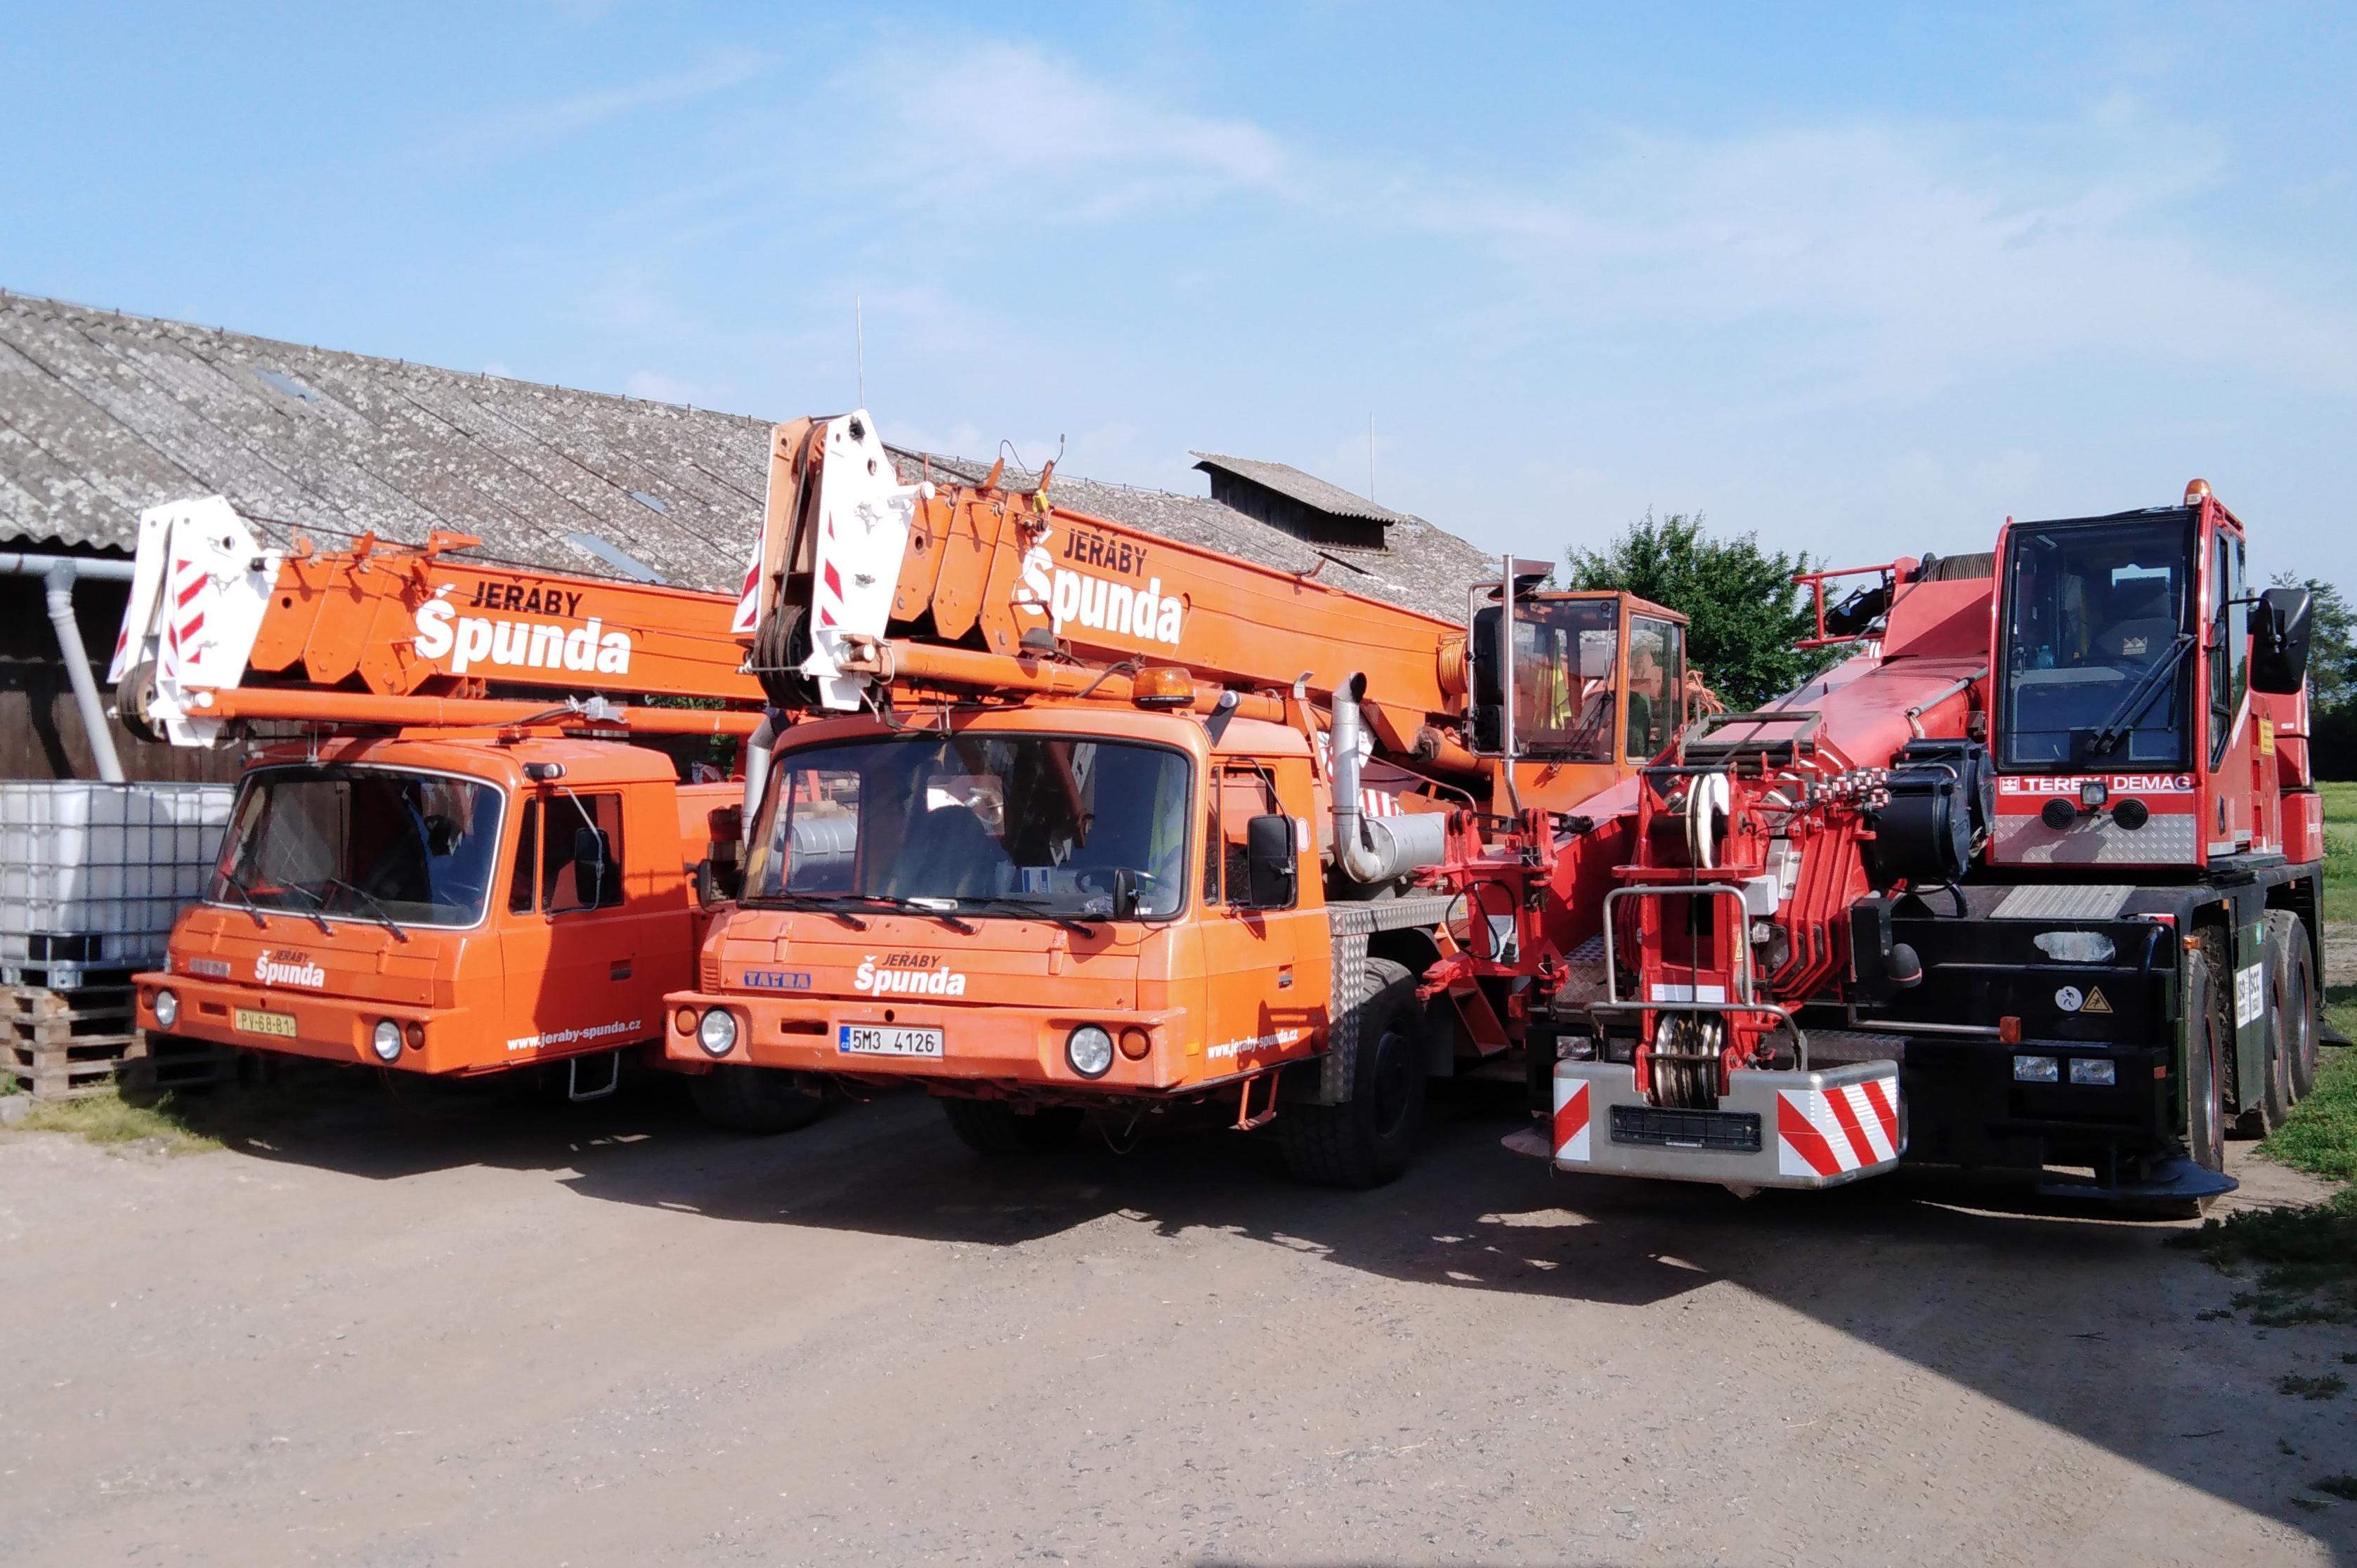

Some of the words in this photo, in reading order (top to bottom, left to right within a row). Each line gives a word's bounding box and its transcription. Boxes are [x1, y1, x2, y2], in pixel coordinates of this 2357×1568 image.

[1063, 527, 1147, 577] JEŘÁBY
[469, 576, 584, 617] JEŘÁBY
[2114, 776, 2190, 790] DEMAG
[254, 950, 325, 987] Špunda
[882, 950, 941, 968] JEŘÁBY
[745, 971, 811, 989] TATRA
[854, 955, 967, 996] Špunda
[240, 1012, 290, 1035] PV-68-81
[507, 1019, 641, 1051] www.jeraby-spunda.cz
[853, 1030, 881, 1050] 5M3
[894, 1033, 935, 1052] 4126
[1208, 1028, 1298, 1059] www.jeraby-spunda.cz
